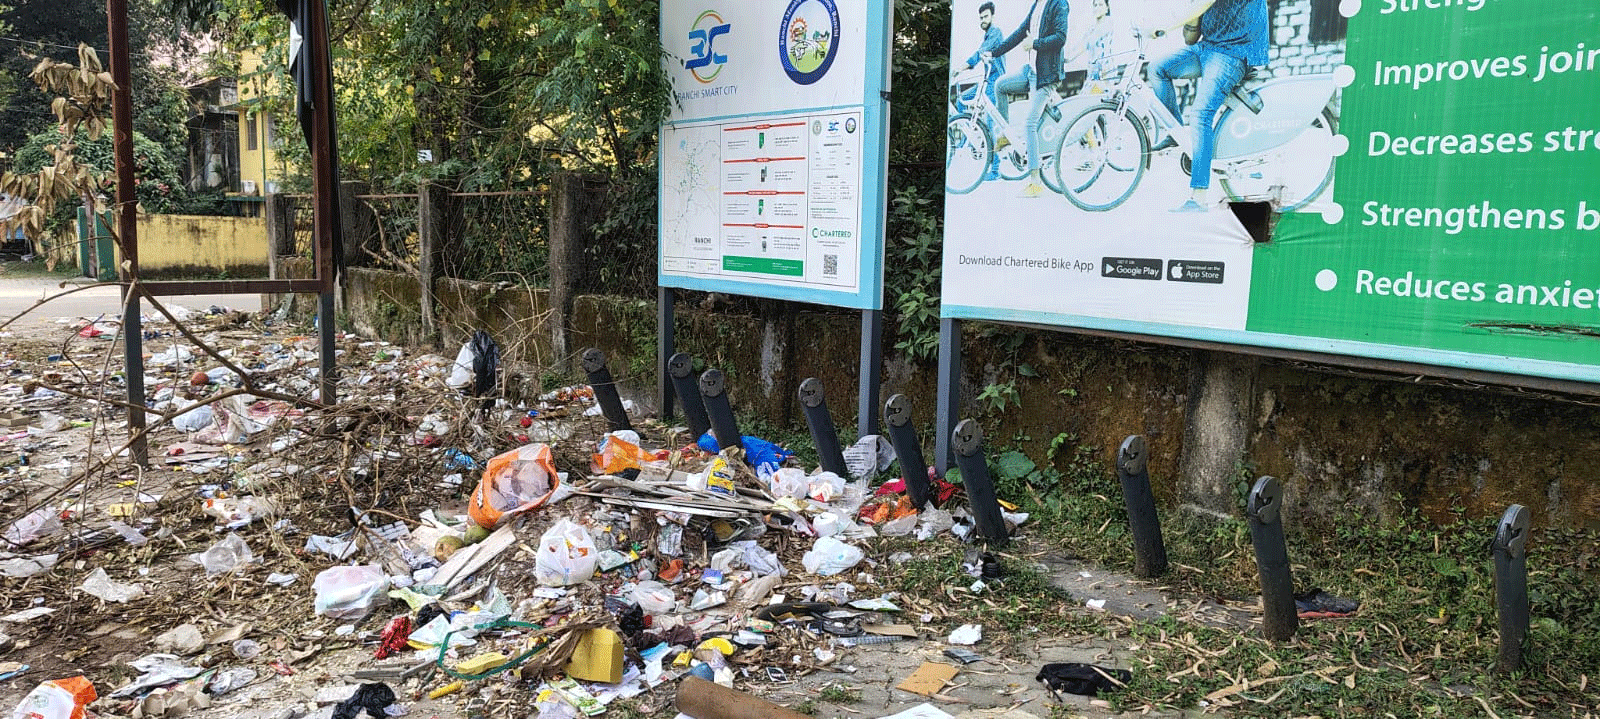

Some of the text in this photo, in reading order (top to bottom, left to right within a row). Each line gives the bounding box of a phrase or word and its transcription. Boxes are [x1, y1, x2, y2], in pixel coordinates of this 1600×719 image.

[1374, 54, 1527, 90] Improves
[677, 84, 737, 101] RANCHI SMART CITY
[1368, 130, 1533, 156] Decreases
[1361, 200, 1566, 235] Strengthens
[820, 229, 852, 238] CHARTERED
[959, 254, 1095, 271] Download Chartered Bike App
[1116, 265, 1159, 277] Google Play
[1186, 270, 1219, 279] App Store
[1355, 269, 1486, 302] Reduces
